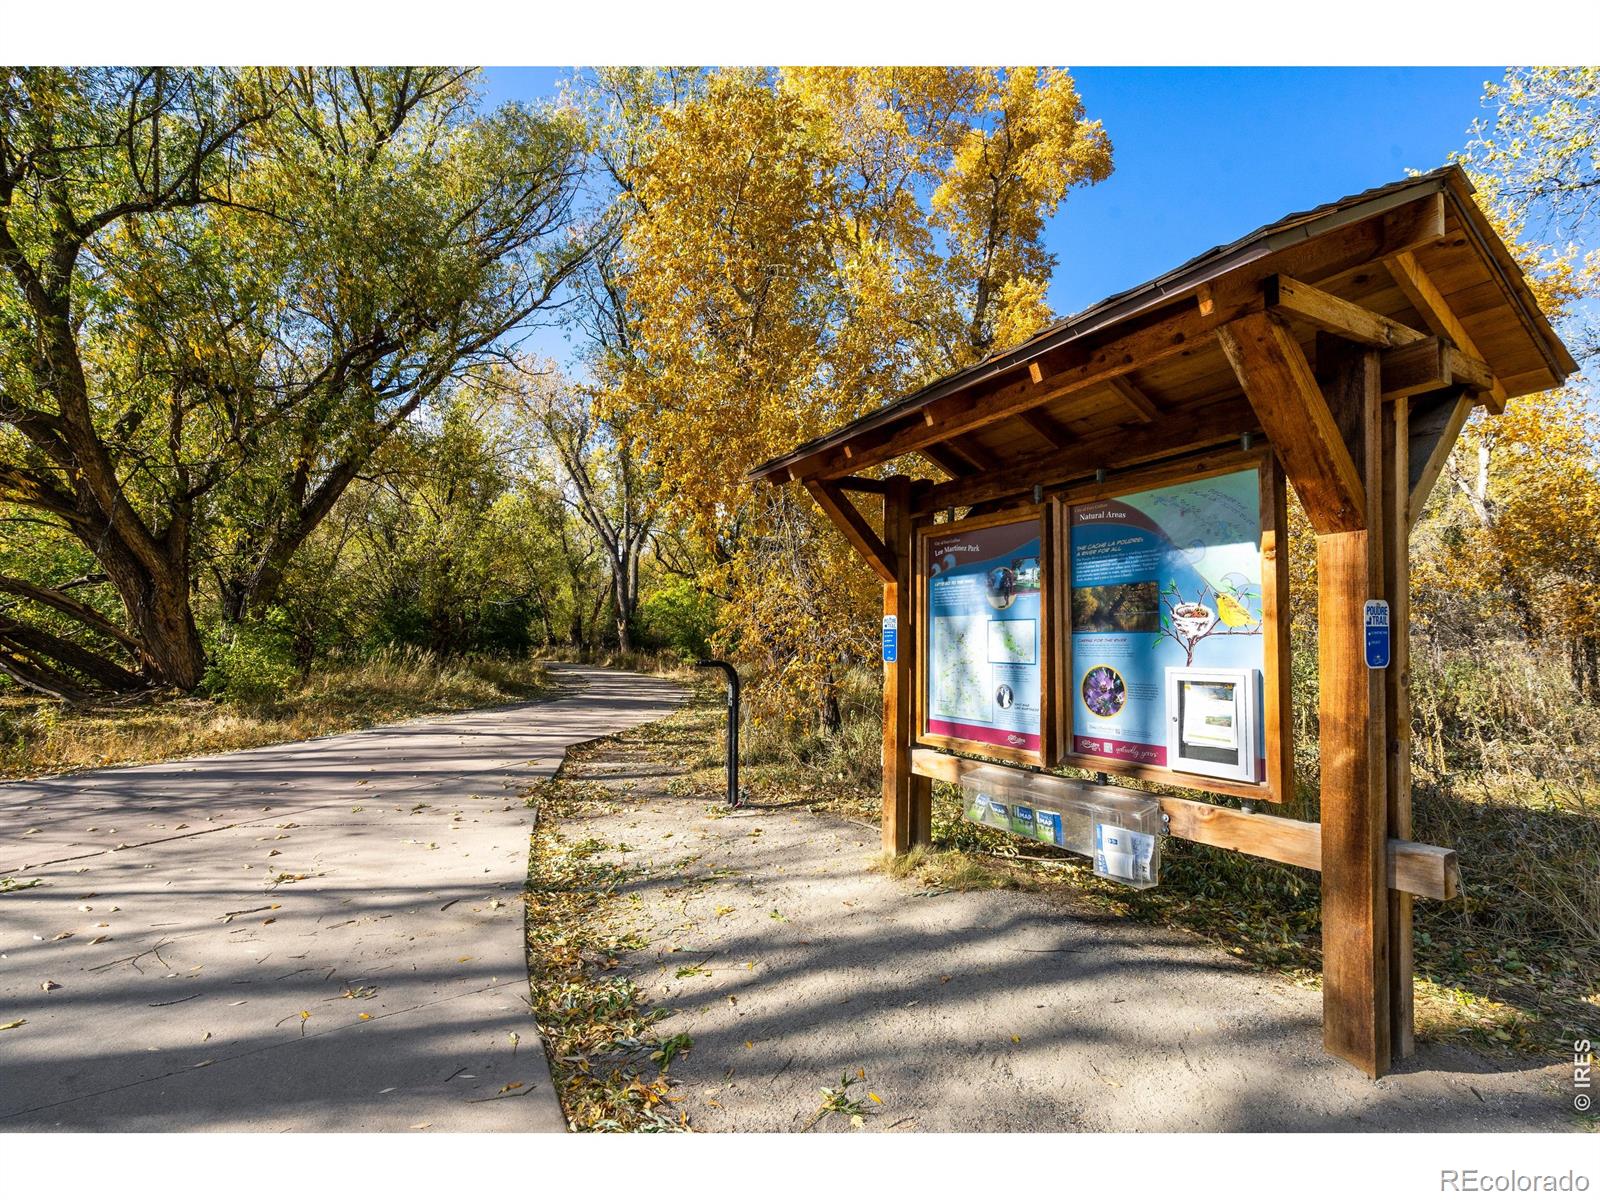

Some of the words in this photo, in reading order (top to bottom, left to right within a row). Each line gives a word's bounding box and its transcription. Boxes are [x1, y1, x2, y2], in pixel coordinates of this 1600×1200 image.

[1079, 510, 1105, 521] Natural
[1106, 511, 1126, 519] Areas
[944, 545, 967, 553] Martinez
[967, 544, 980, 552] Park
[1366, 606, 1388, 615] POUDRE
[1371, 616, 1387, 625] TRAIL
[1039, 818, 1053, 826] MAP
